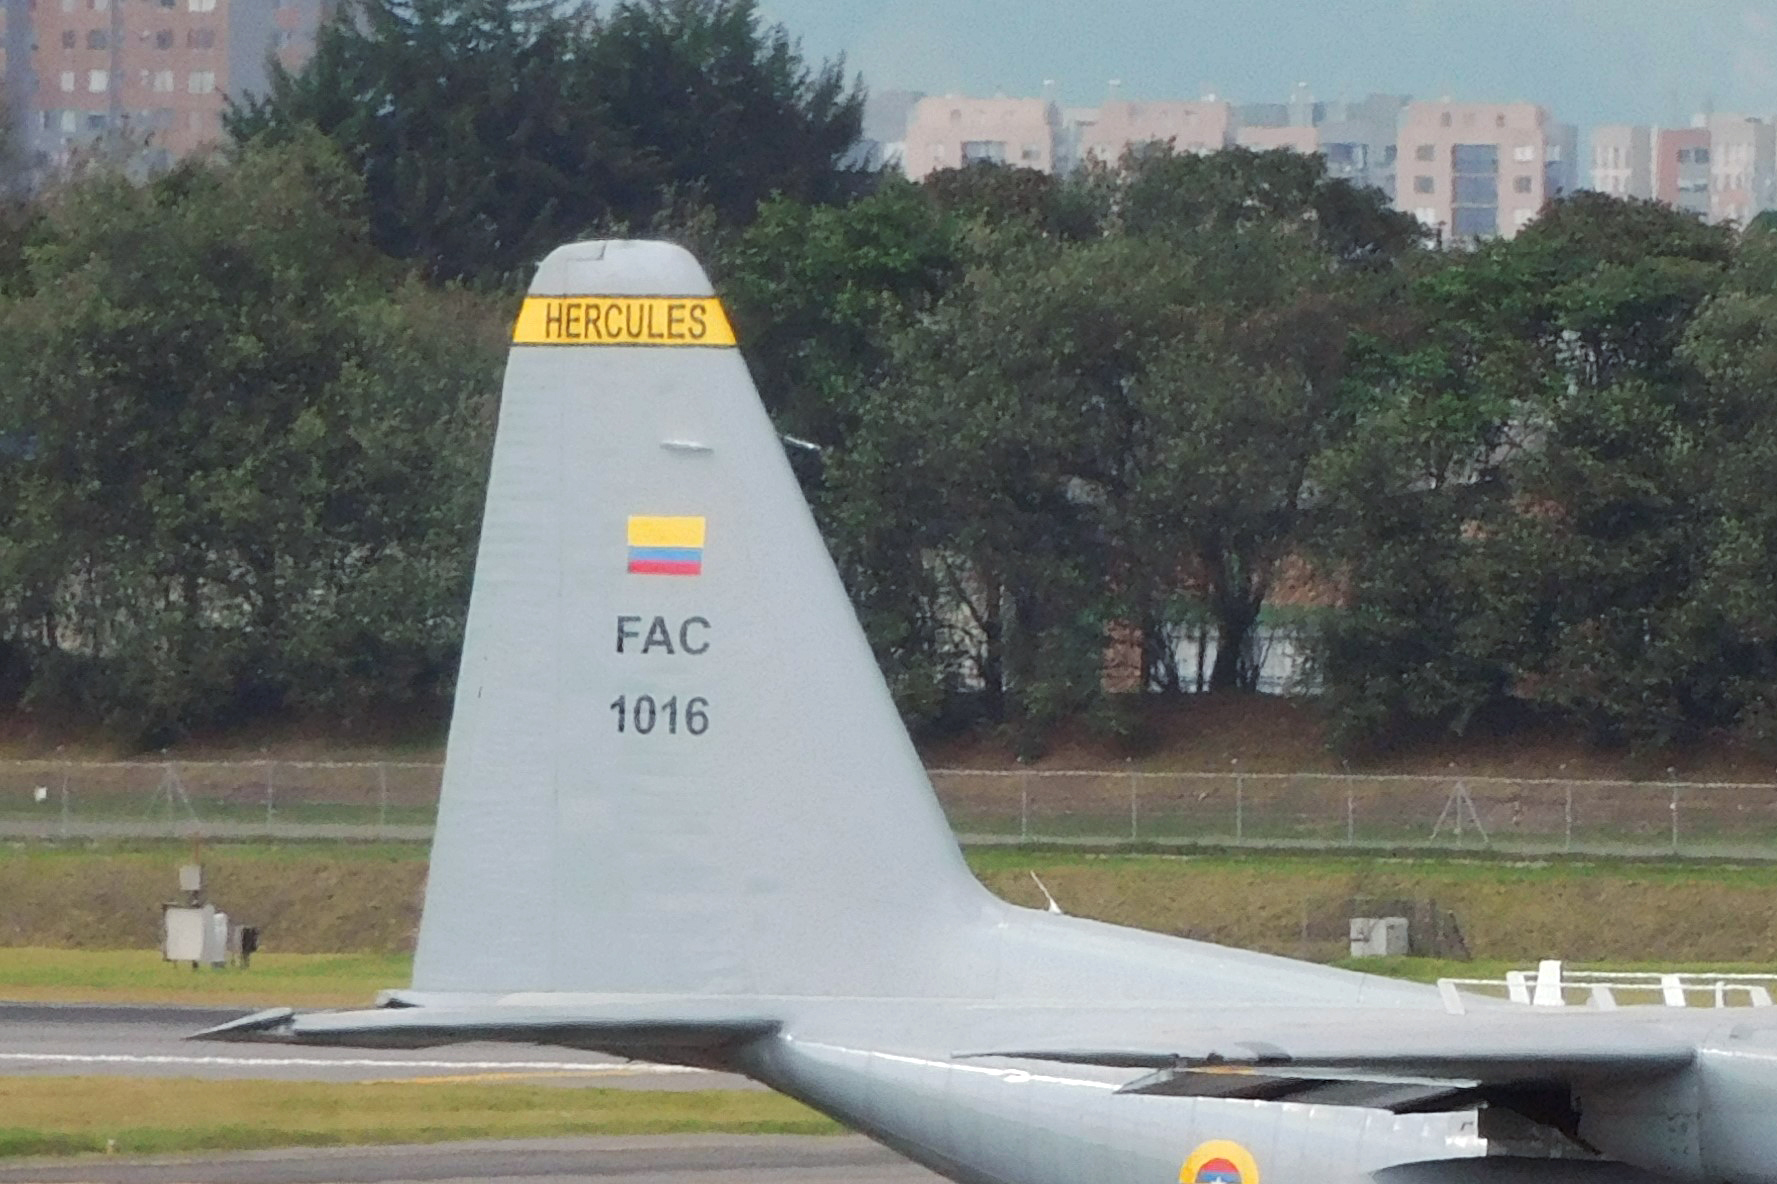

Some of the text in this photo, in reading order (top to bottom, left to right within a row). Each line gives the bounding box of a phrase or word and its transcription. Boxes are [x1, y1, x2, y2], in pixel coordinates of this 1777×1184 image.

[545, 302, 708, 340] HERCULES
[615, 615, 712, 656] FAC
[609, 694, 710, 736] 1016
